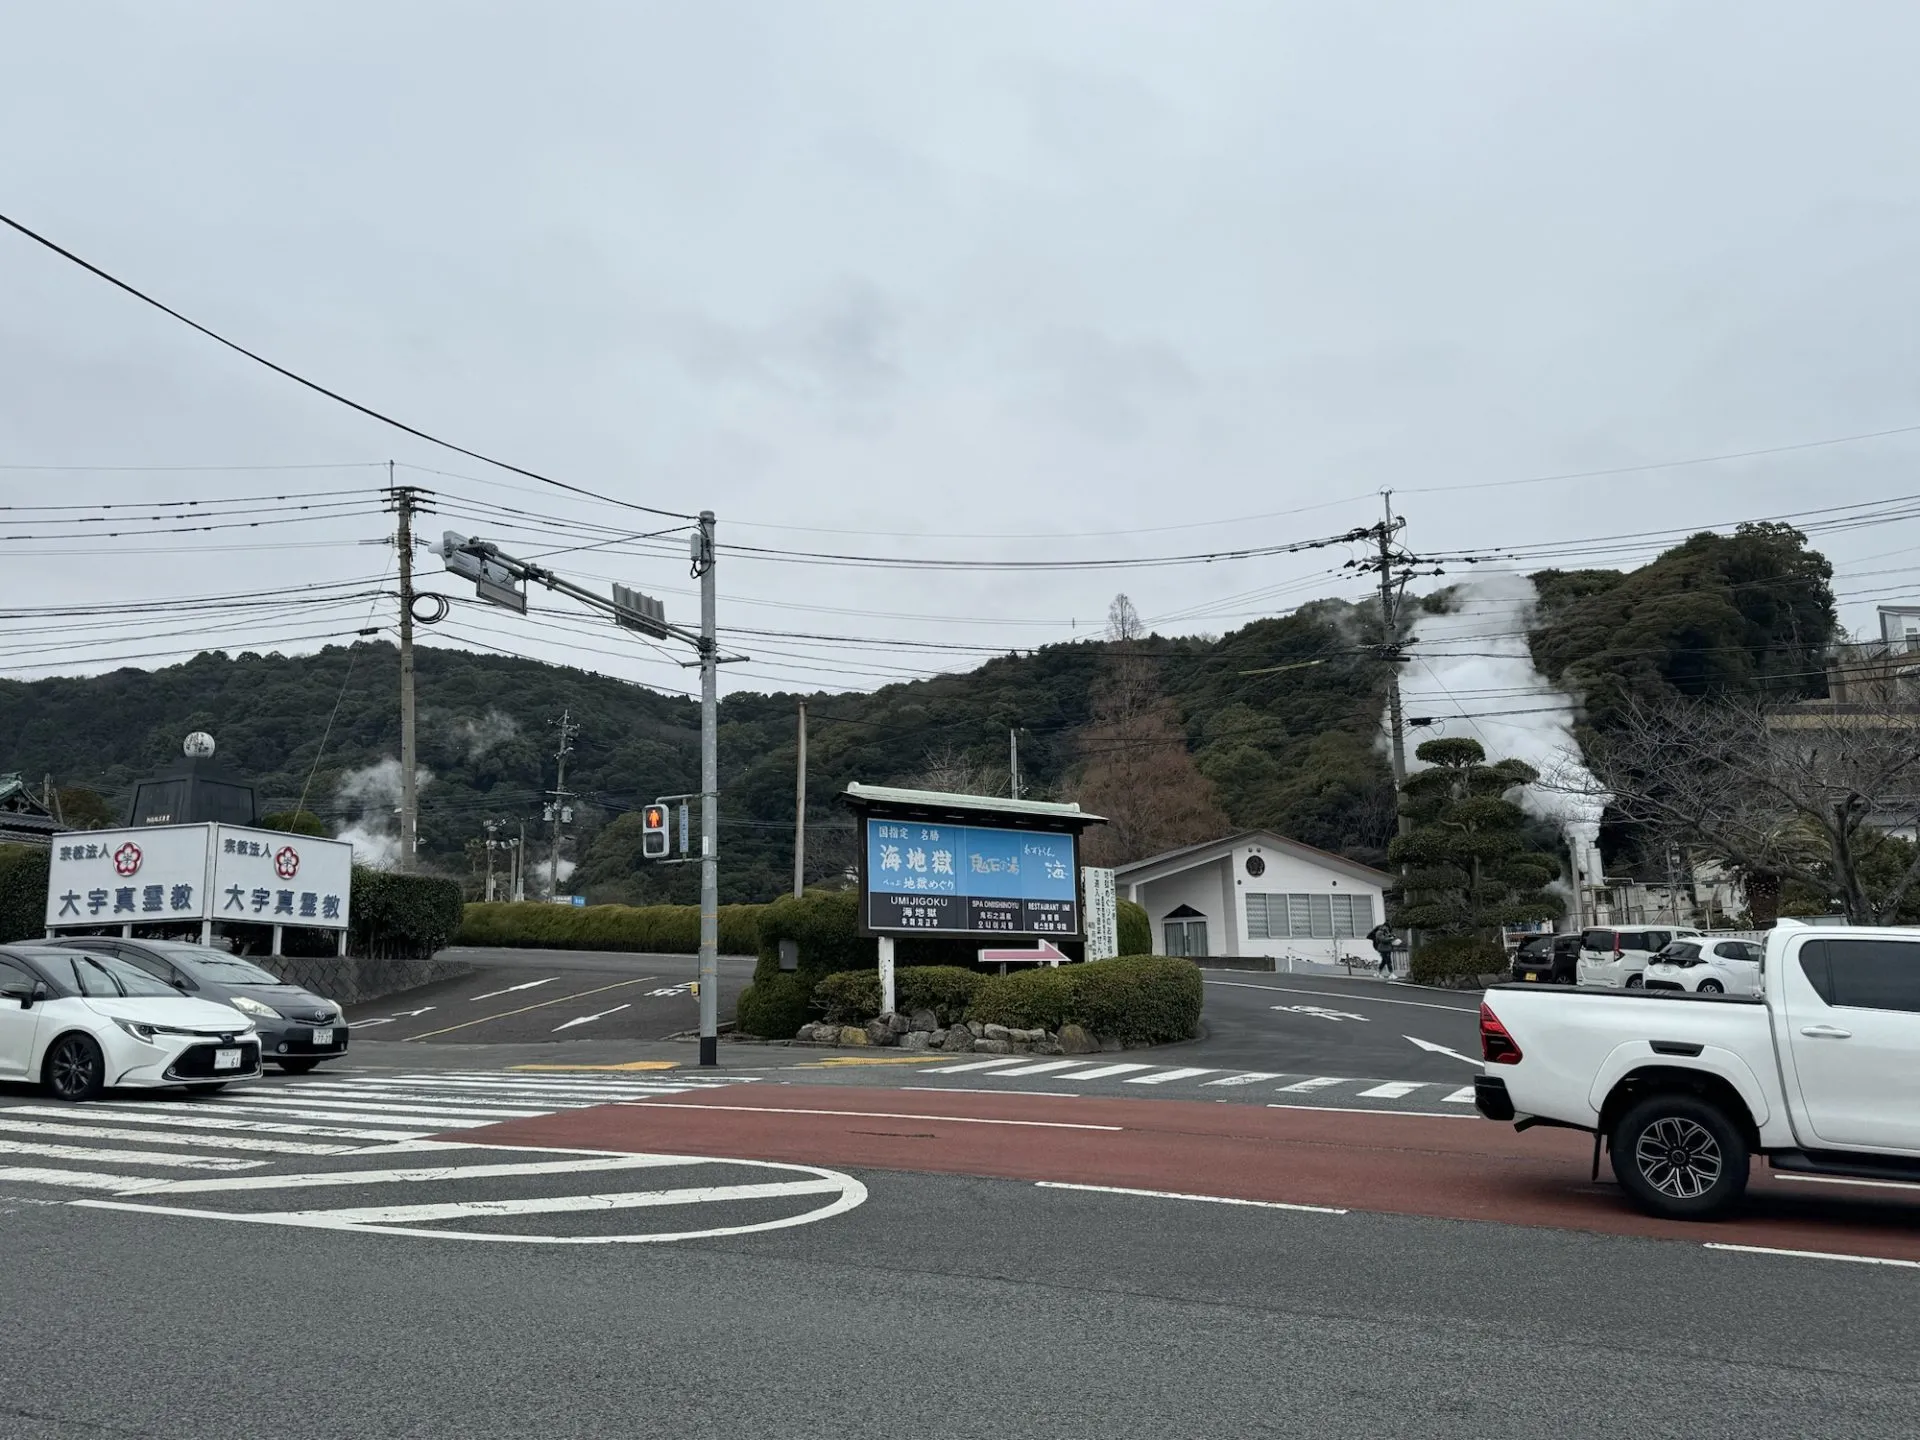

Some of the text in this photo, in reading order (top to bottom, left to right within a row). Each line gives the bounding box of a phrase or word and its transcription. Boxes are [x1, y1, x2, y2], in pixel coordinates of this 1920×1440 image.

[879, 826, 940, 841] 国指定 名勝
[59, 843, 111, 861] 宗教法人
[224, 839, 272, 858] 宗教法人
[880, 844, 954, 875] 海地獄
[1044, 859, 1068, 880] 海
[58, 883, 194, 917] 大宇真霊教
[223, 883, 341, 919] 大宇真霊教
[890, 896, 948, 907] UMIJIGOKU
[972, 900, 984, 908] SPA
[1028, 902, 1059, 911] RESTAURANT
[902, 907, 937, 918] 海地獄
